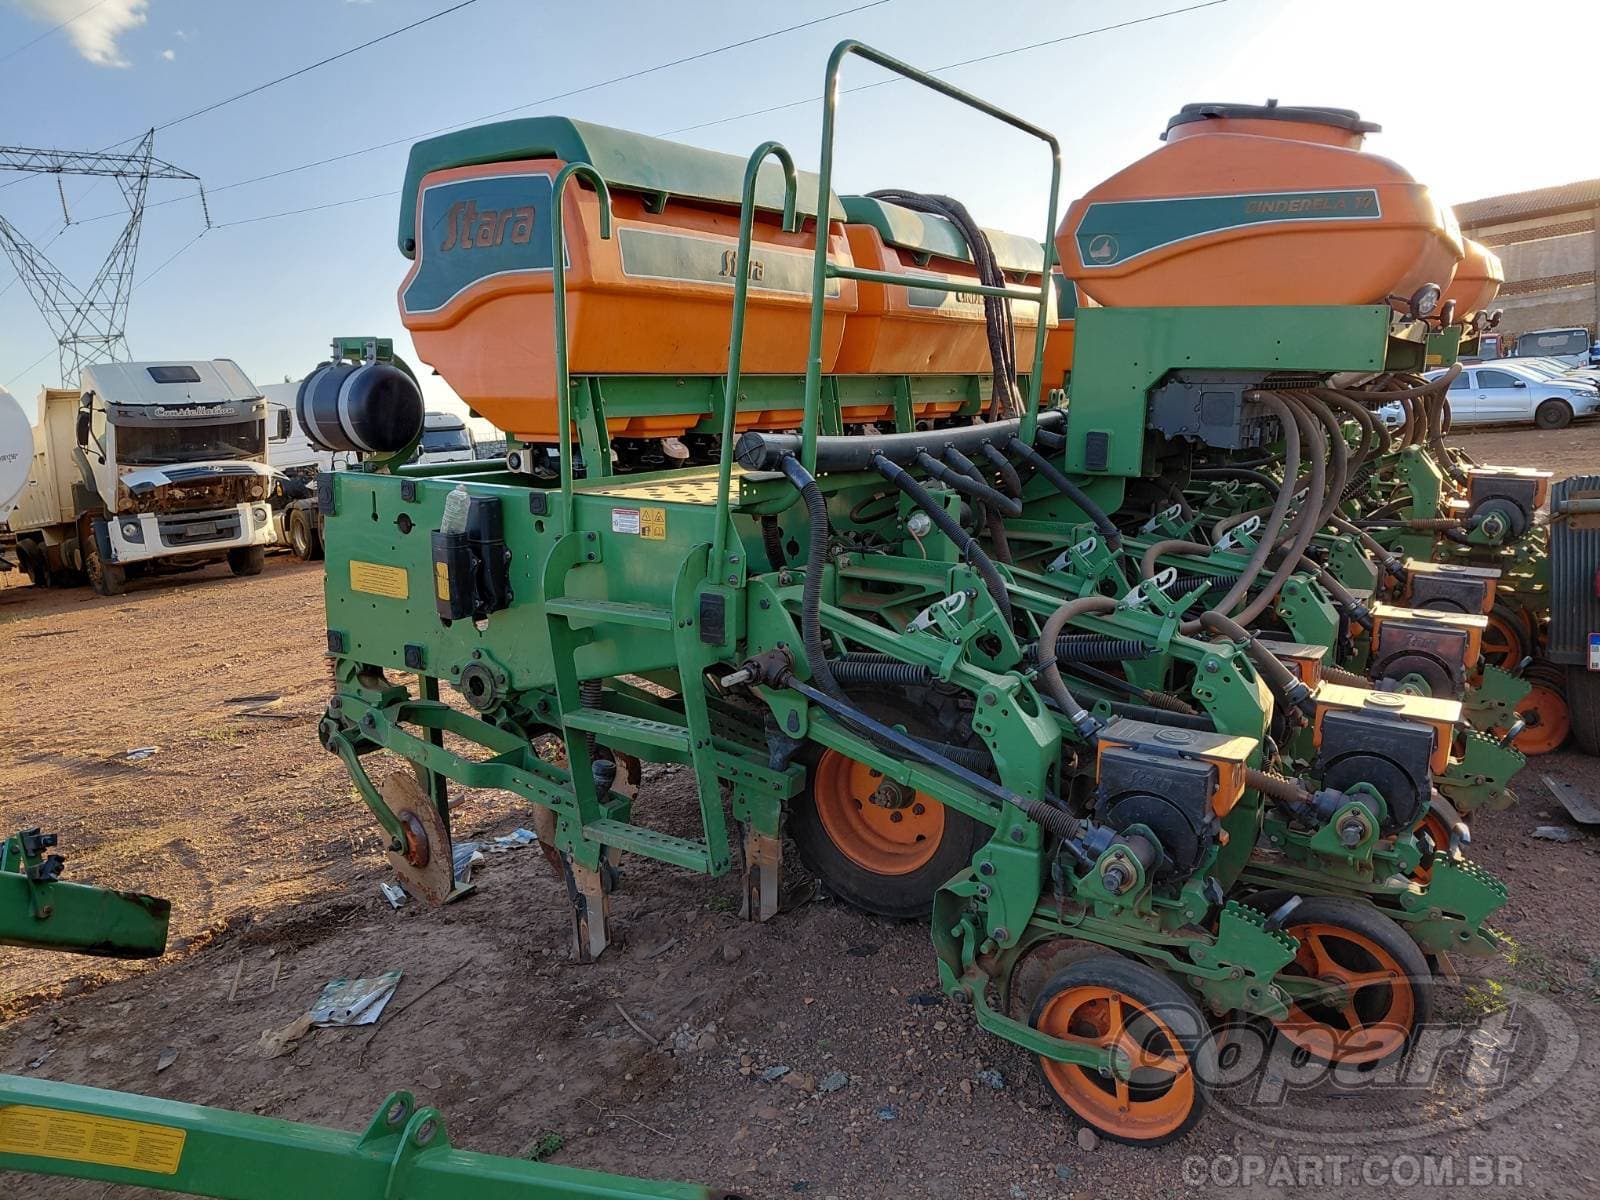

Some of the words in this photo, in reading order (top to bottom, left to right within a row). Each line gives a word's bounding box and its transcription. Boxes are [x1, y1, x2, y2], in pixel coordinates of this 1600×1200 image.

[1246, 197, 1345, 213] CINDERELA
[440, 199, 535, 252] Stara
[719, 249, 764, 281] Stra
[154, 405, 235, 417] Constellation
